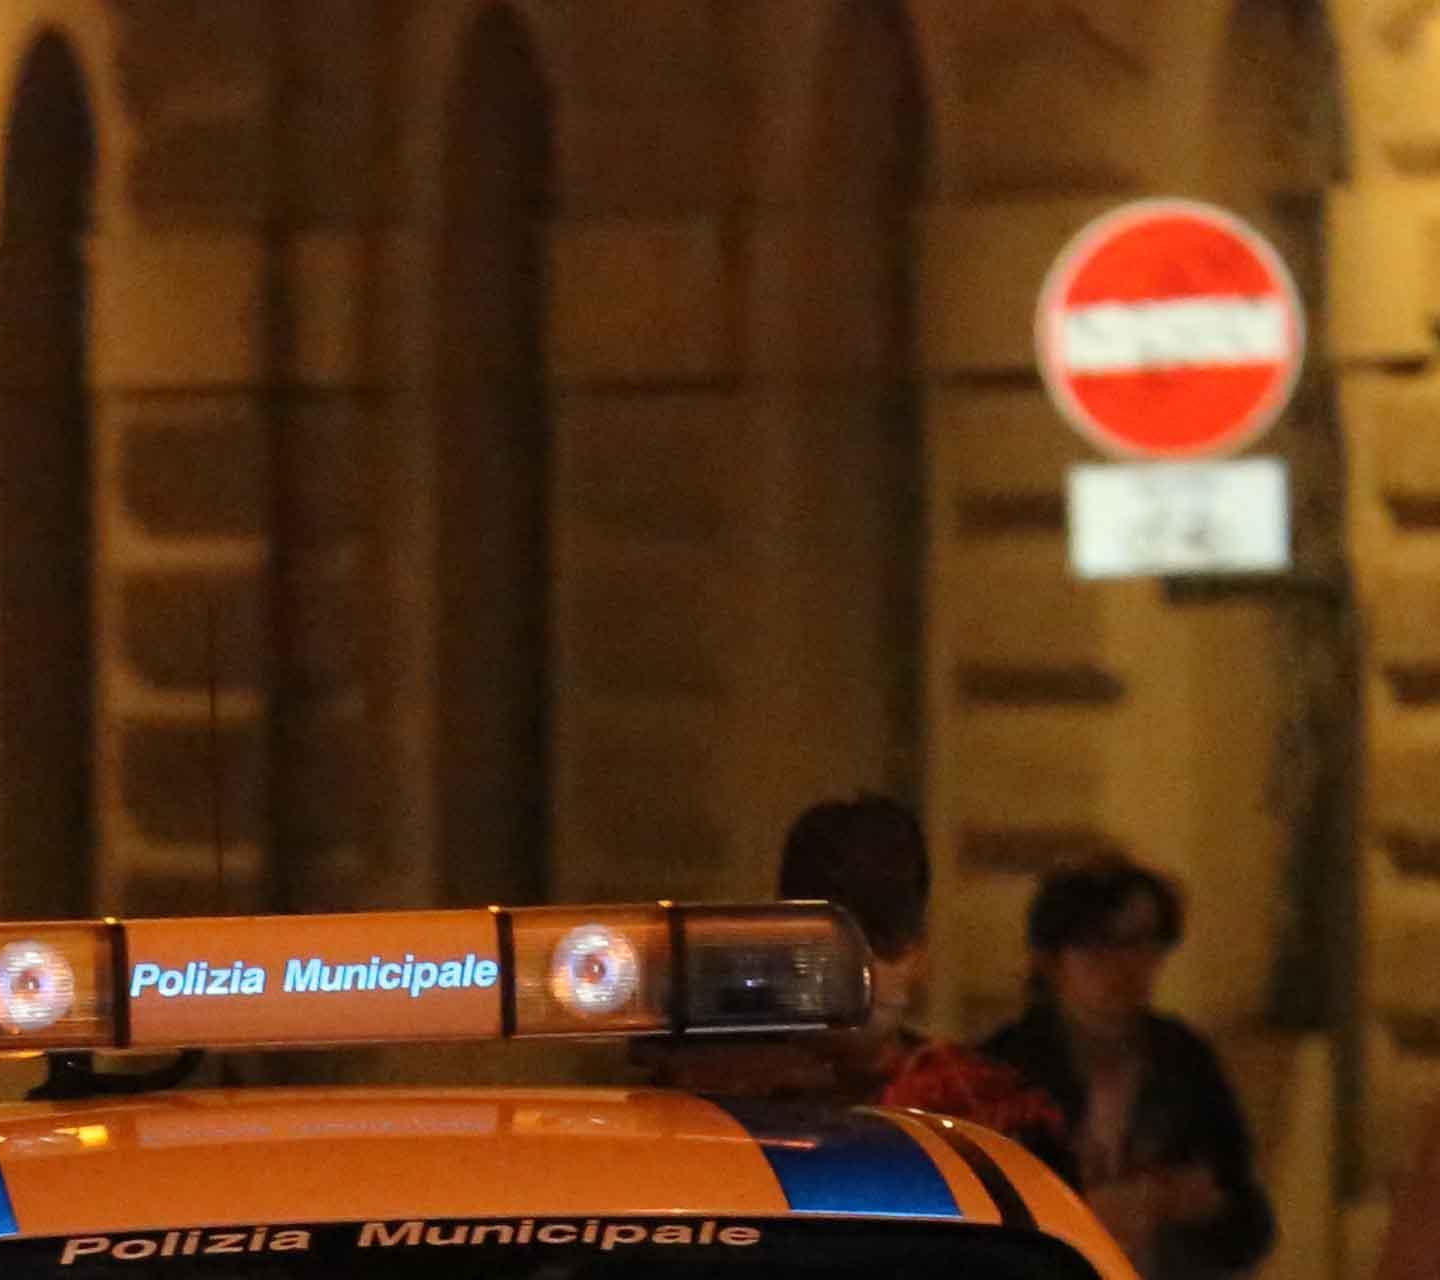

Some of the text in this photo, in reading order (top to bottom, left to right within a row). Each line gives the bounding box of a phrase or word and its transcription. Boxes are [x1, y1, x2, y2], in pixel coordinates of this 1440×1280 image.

[130, 954, 500, 998] Polizia Municipale
[59, 1219, 762, 1264] Polizia Municipale
